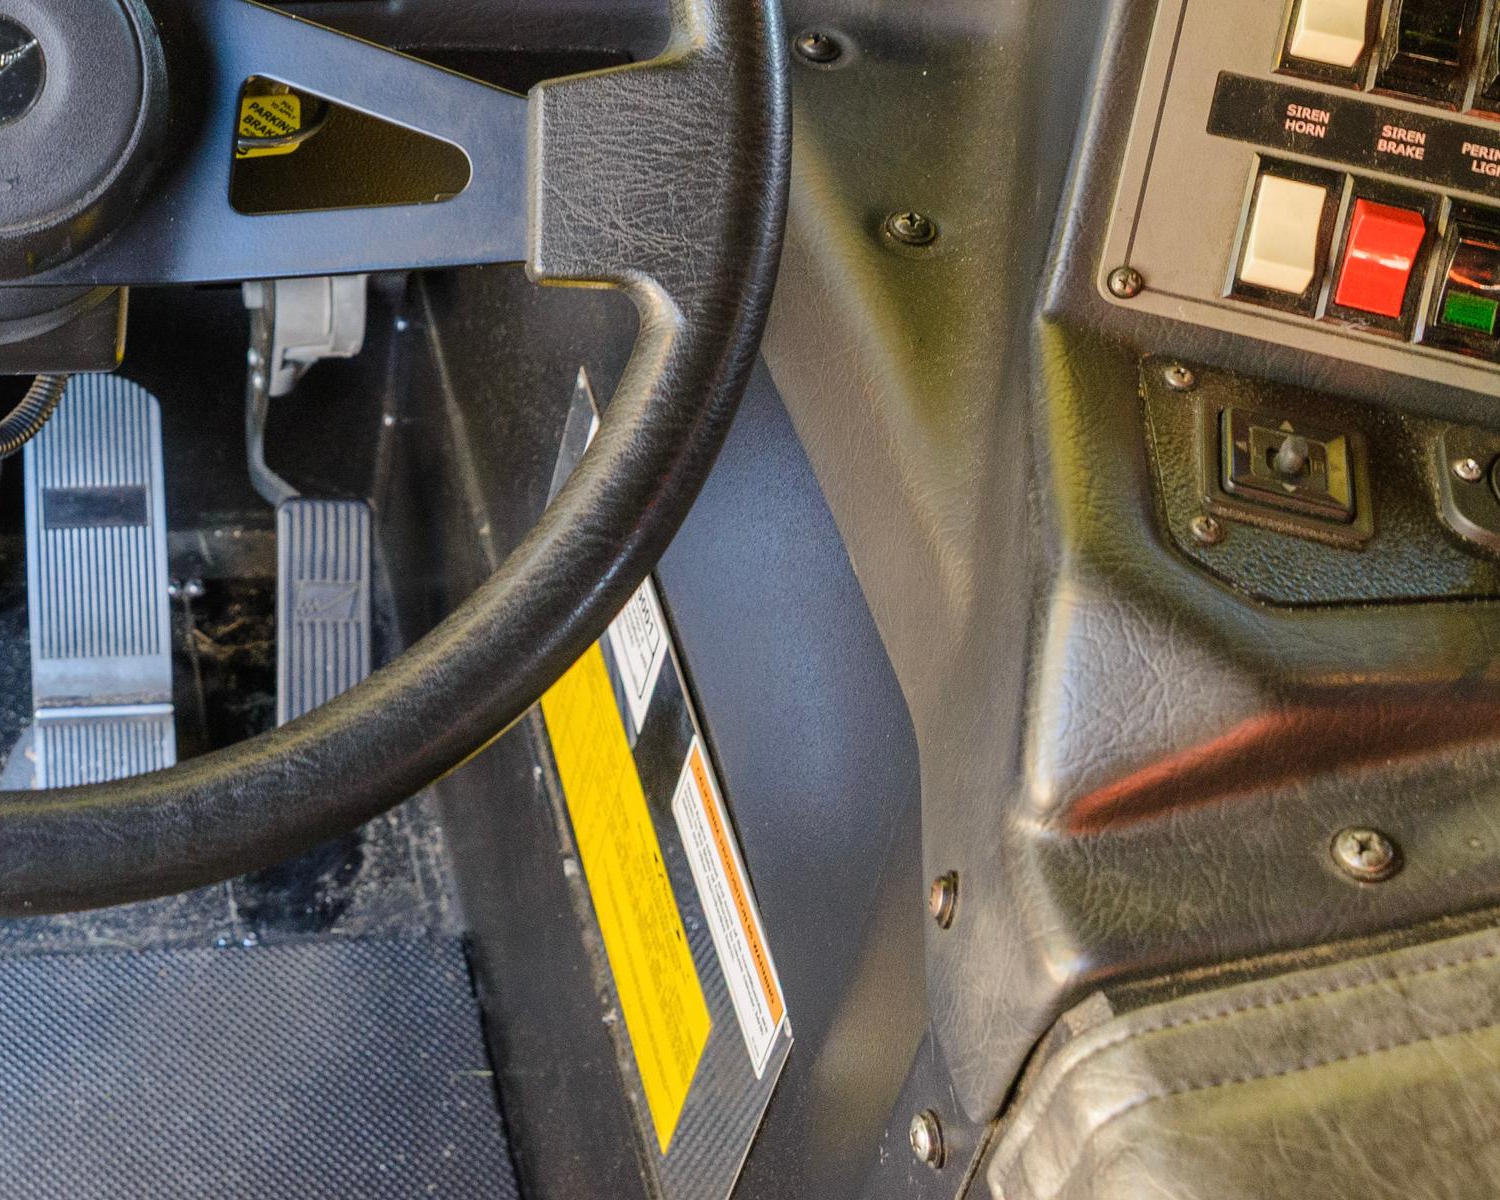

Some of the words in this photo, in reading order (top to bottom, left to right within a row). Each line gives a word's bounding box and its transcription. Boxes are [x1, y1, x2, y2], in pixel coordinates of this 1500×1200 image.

[1287, 103, 1331, 124] SIREN
[243, 114, 277, 137] BRAK
[1284, 118, 1326, 139] HORN
[1382, 124, 1426, 146] SIREN
[1377, 138, 1426, 161] BRAKE
